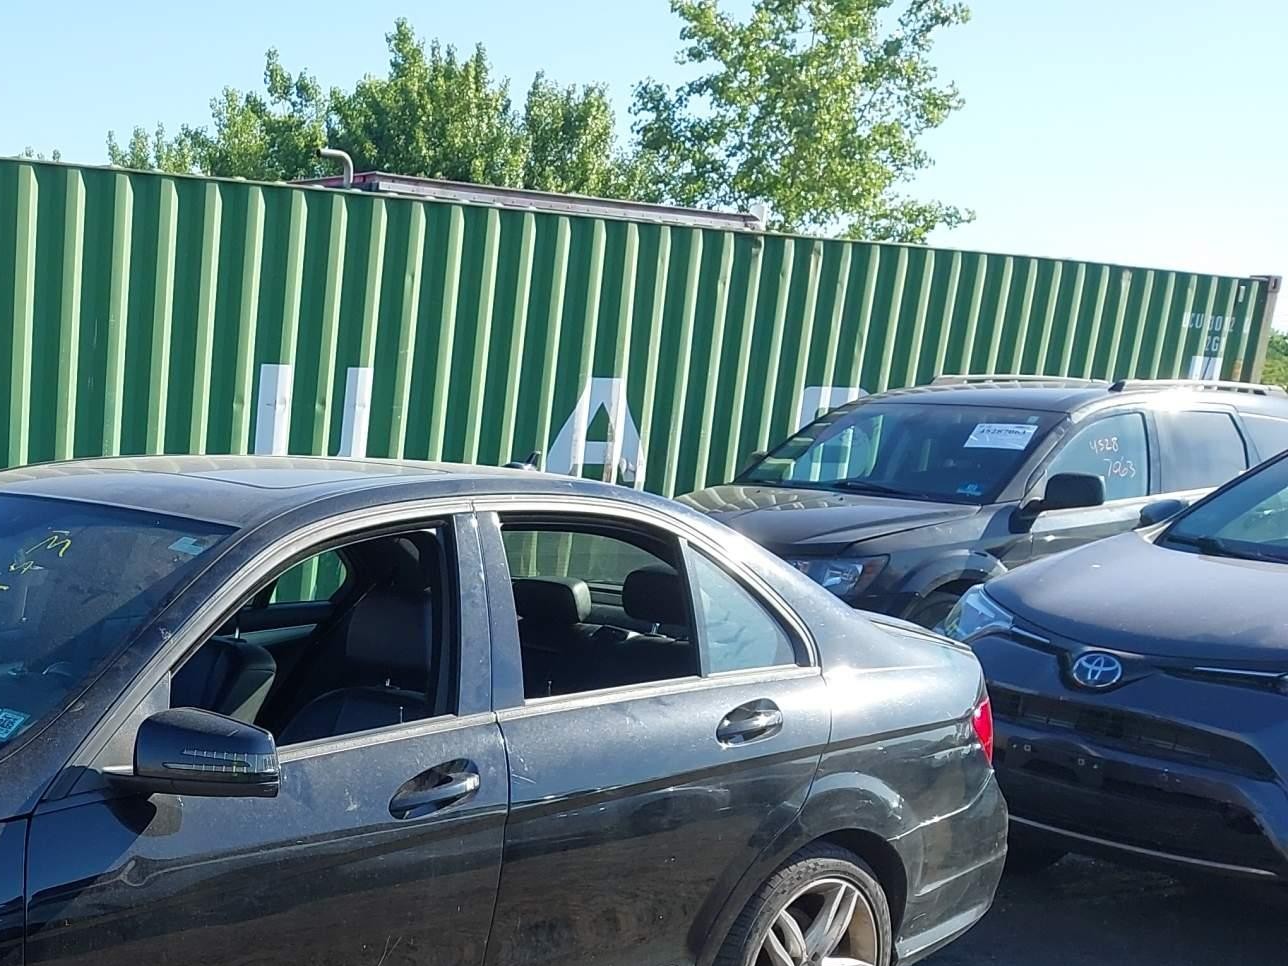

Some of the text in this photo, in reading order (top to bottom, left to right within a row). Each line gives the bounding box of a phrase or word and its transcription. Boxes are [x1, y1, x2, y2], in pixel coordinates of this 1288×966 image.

[546, 376, 645, 488] A
[1089, 437, 1118, 453] 4528
[1104, 457, 1136, 478] 7063
